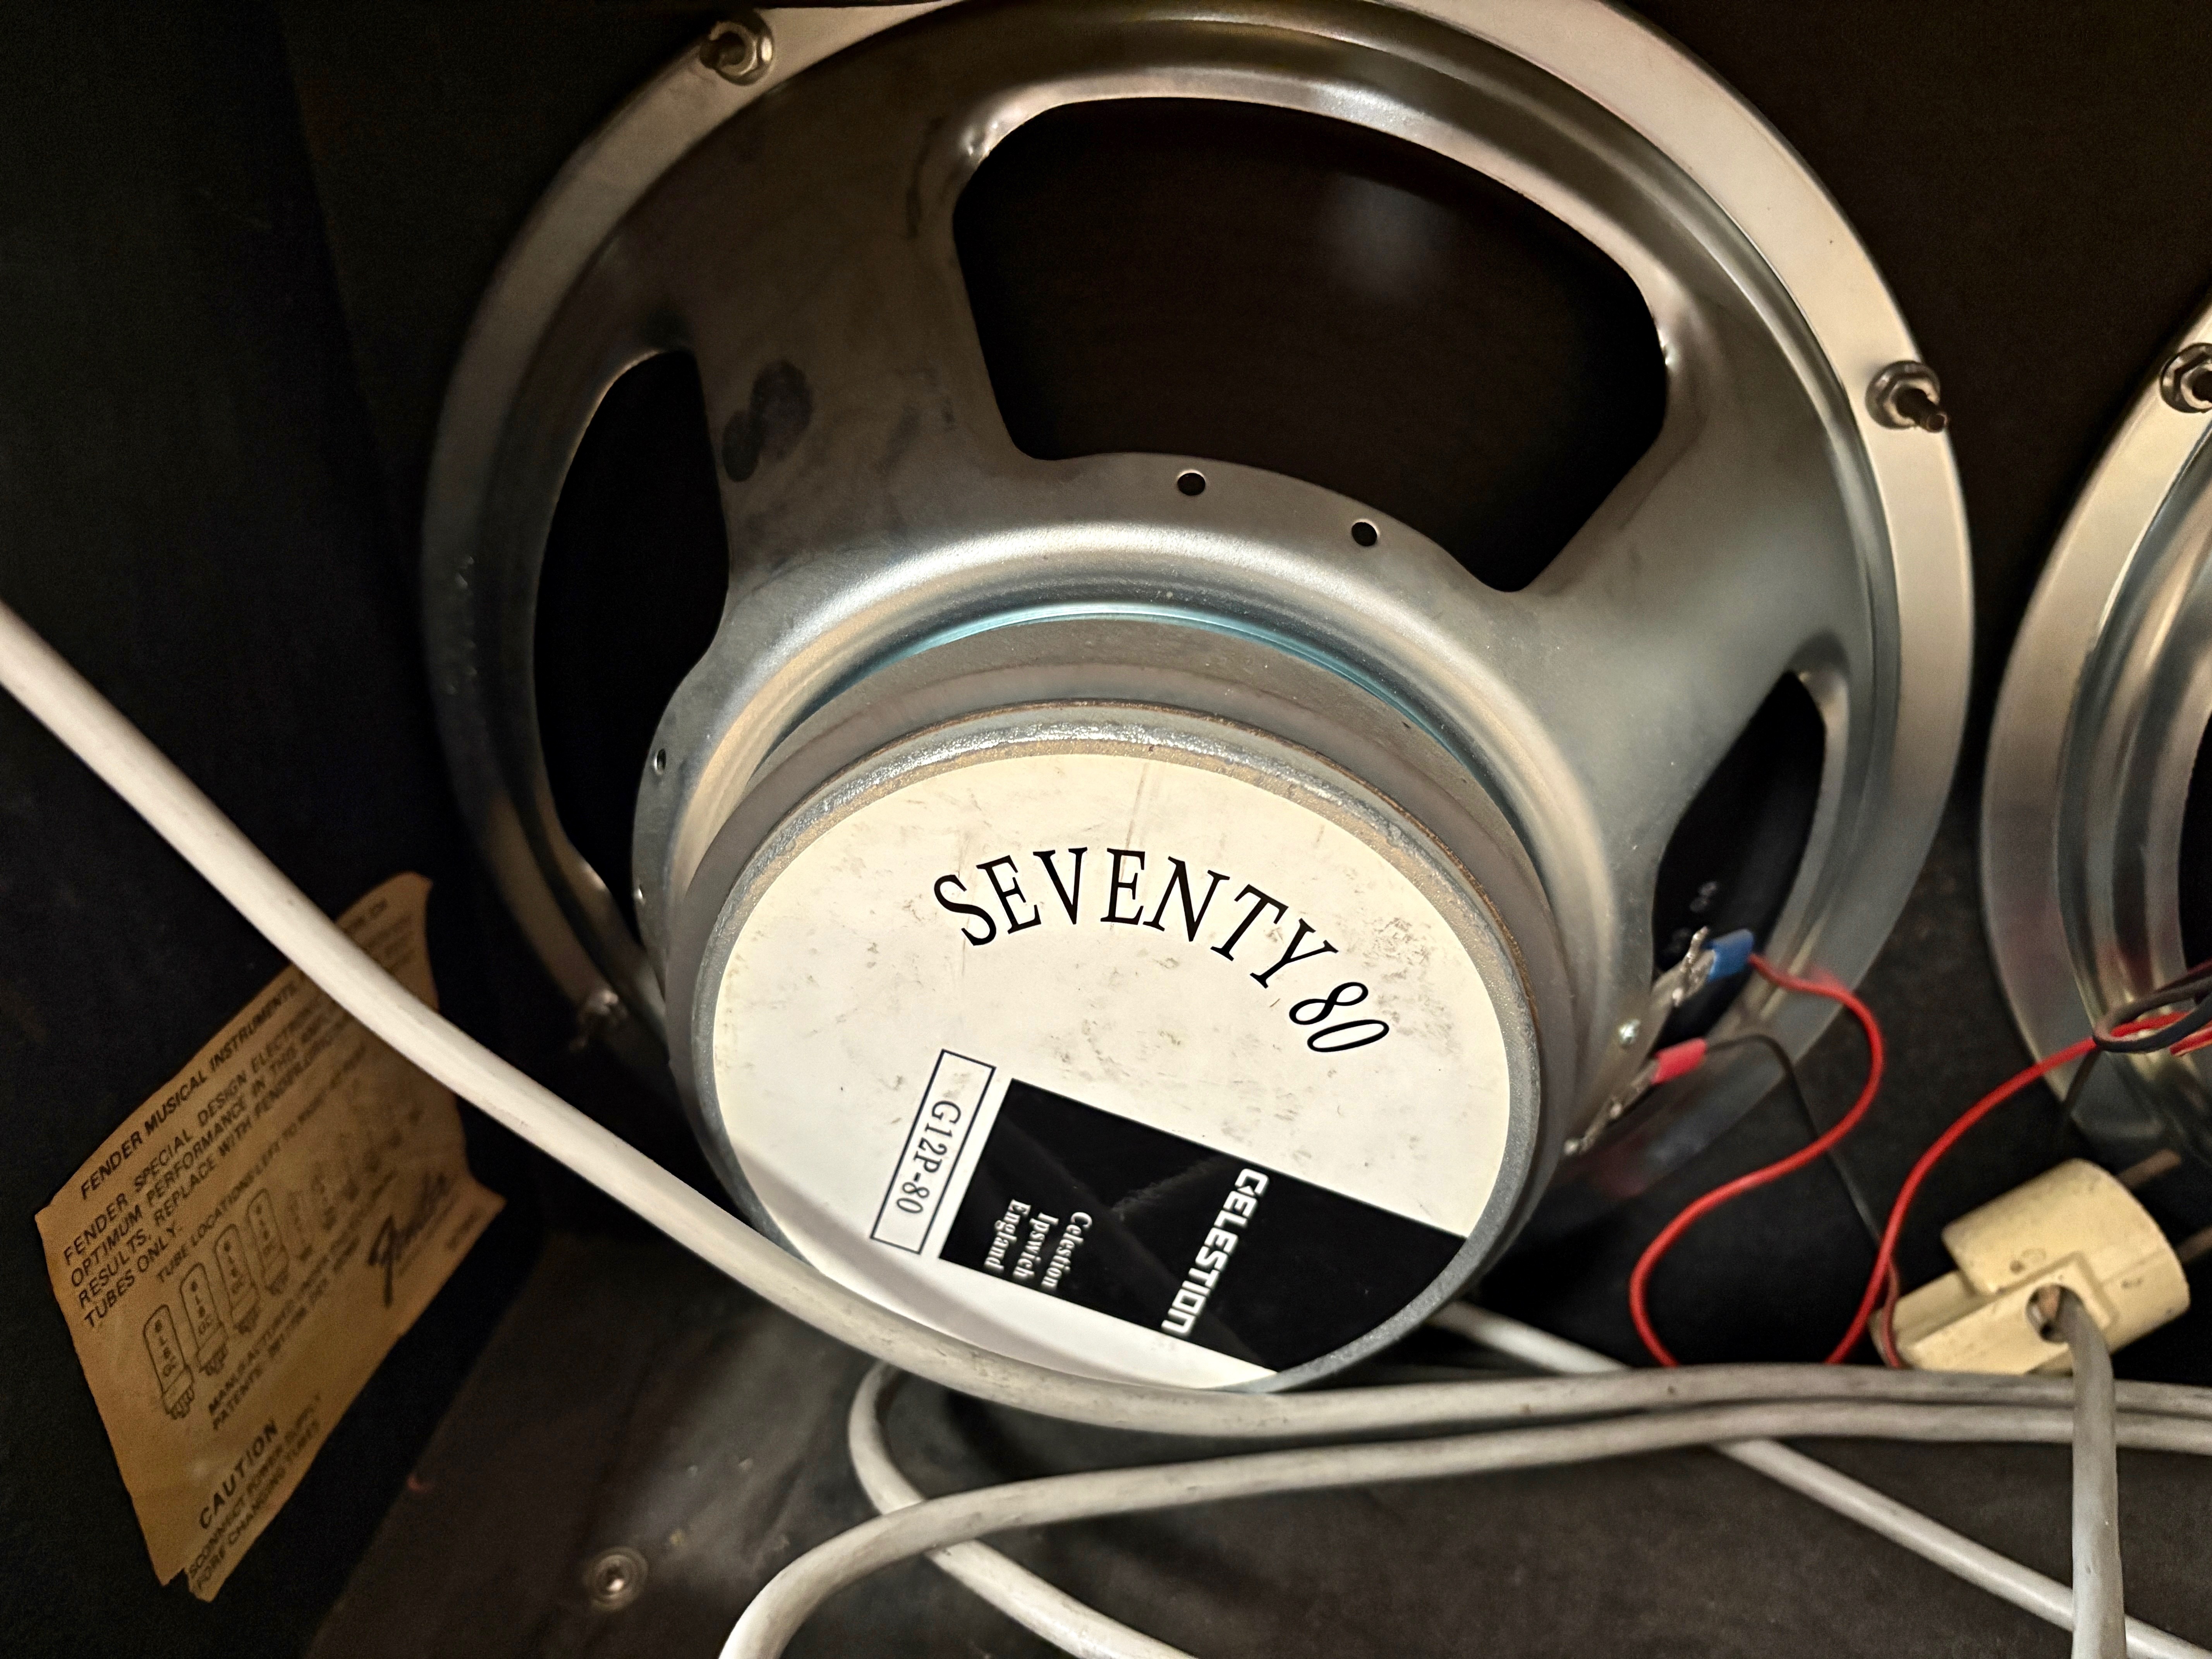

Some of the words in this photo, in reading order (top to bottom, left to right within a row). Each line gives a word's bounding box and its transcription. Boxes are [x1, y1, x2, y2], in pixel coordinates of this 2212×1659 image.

[934, 847, 1338, 988] SEVENTY
[1289, 982, 1389, 1053] 80
[63, 1190, 128, 1266] FENDER
[132, 1125, 192, 1194] SPECIAL
[197, 1068, 247, 1128] DESIGN
[70, 1203, 143, 1290] OPTIMUM
[146, 1094, 245, 1207] PERFORMANCE
[80, 1129, 143, 1200] FENDER
[144, 1066, 207, 1136] MUSICAL
[896, 1100, 962, 1214] G12P-80
[78, 1223, 151, 1309] RESULTS,
[153, 1153, 216, 1229] REPLACE
[218, 1115, 252, 1159] WITH
[156, 1243, 189, 1286] TUBE
[984, 1199, 1032, 1275] England
[1012, 1212, 1059, 1280] Ipswich
[1041, 1211, 1093, 1291] Celestion
[1161, 1168, 1269, 1336] CELESTION
[84, 1267, 136, 1331] TUBES
[197, 1416, 278, 1534] CAUTION
